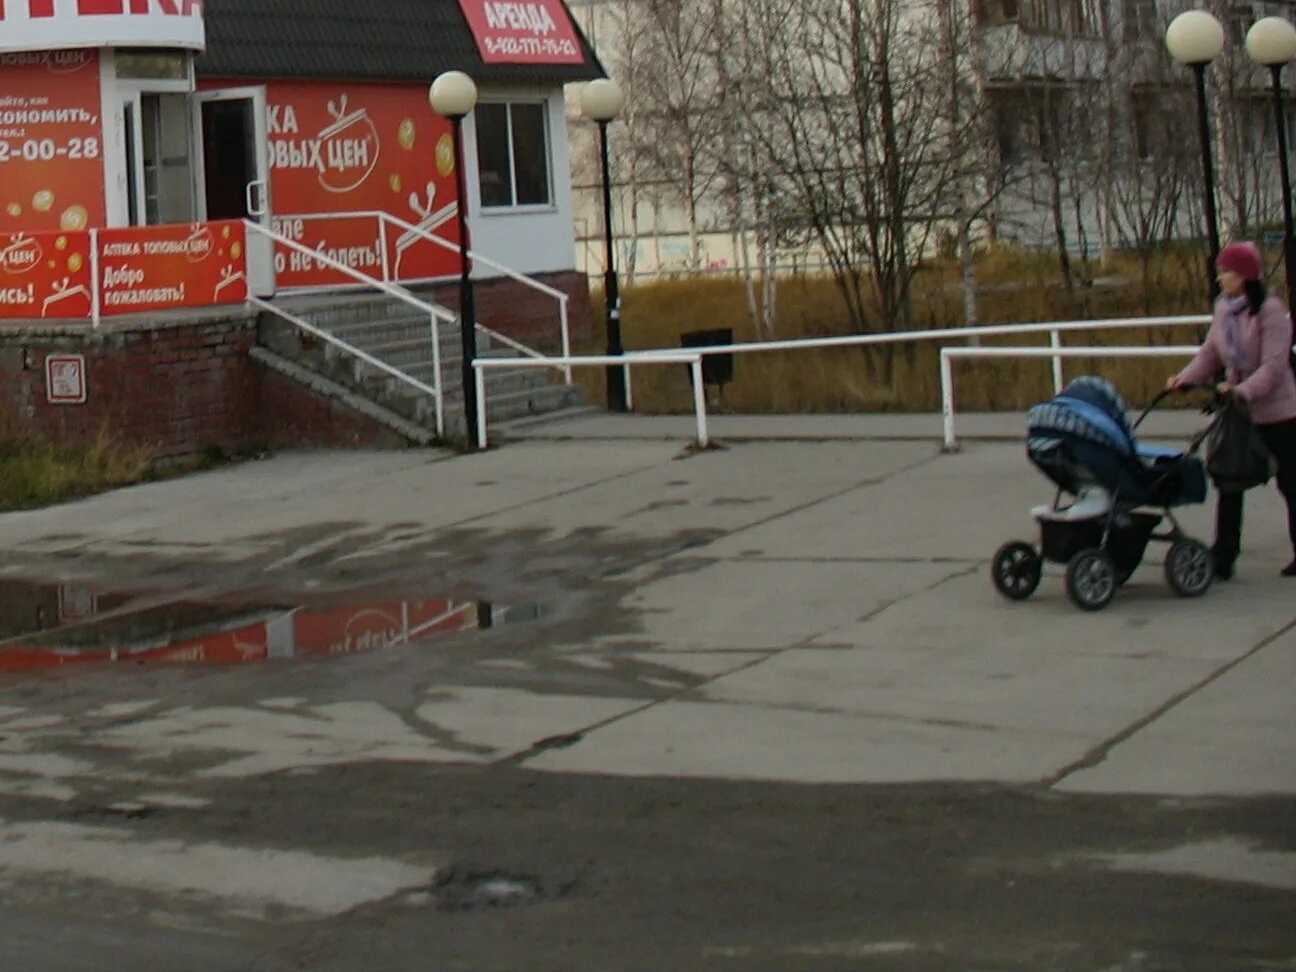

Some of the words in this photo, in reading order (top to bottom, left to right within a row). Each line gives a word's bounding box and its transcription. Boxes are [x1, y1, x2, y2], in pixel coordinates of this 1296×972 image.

[484, 0, 556, 36] АРЕНДА
[327, 138, 369, 172] ЦЕН
[8, 249, 35, 264] ЦЕН
[103, 242, 141, 257] АПТЕКА
[143, 240, 188, 255] ТОПОВЫХ
[290, 250, 312, 272] не
[315, 239, 382, 271] болеть!
[103, 262, 145, 288] Добро
[105, 282, 185, 306] пожаловать!
